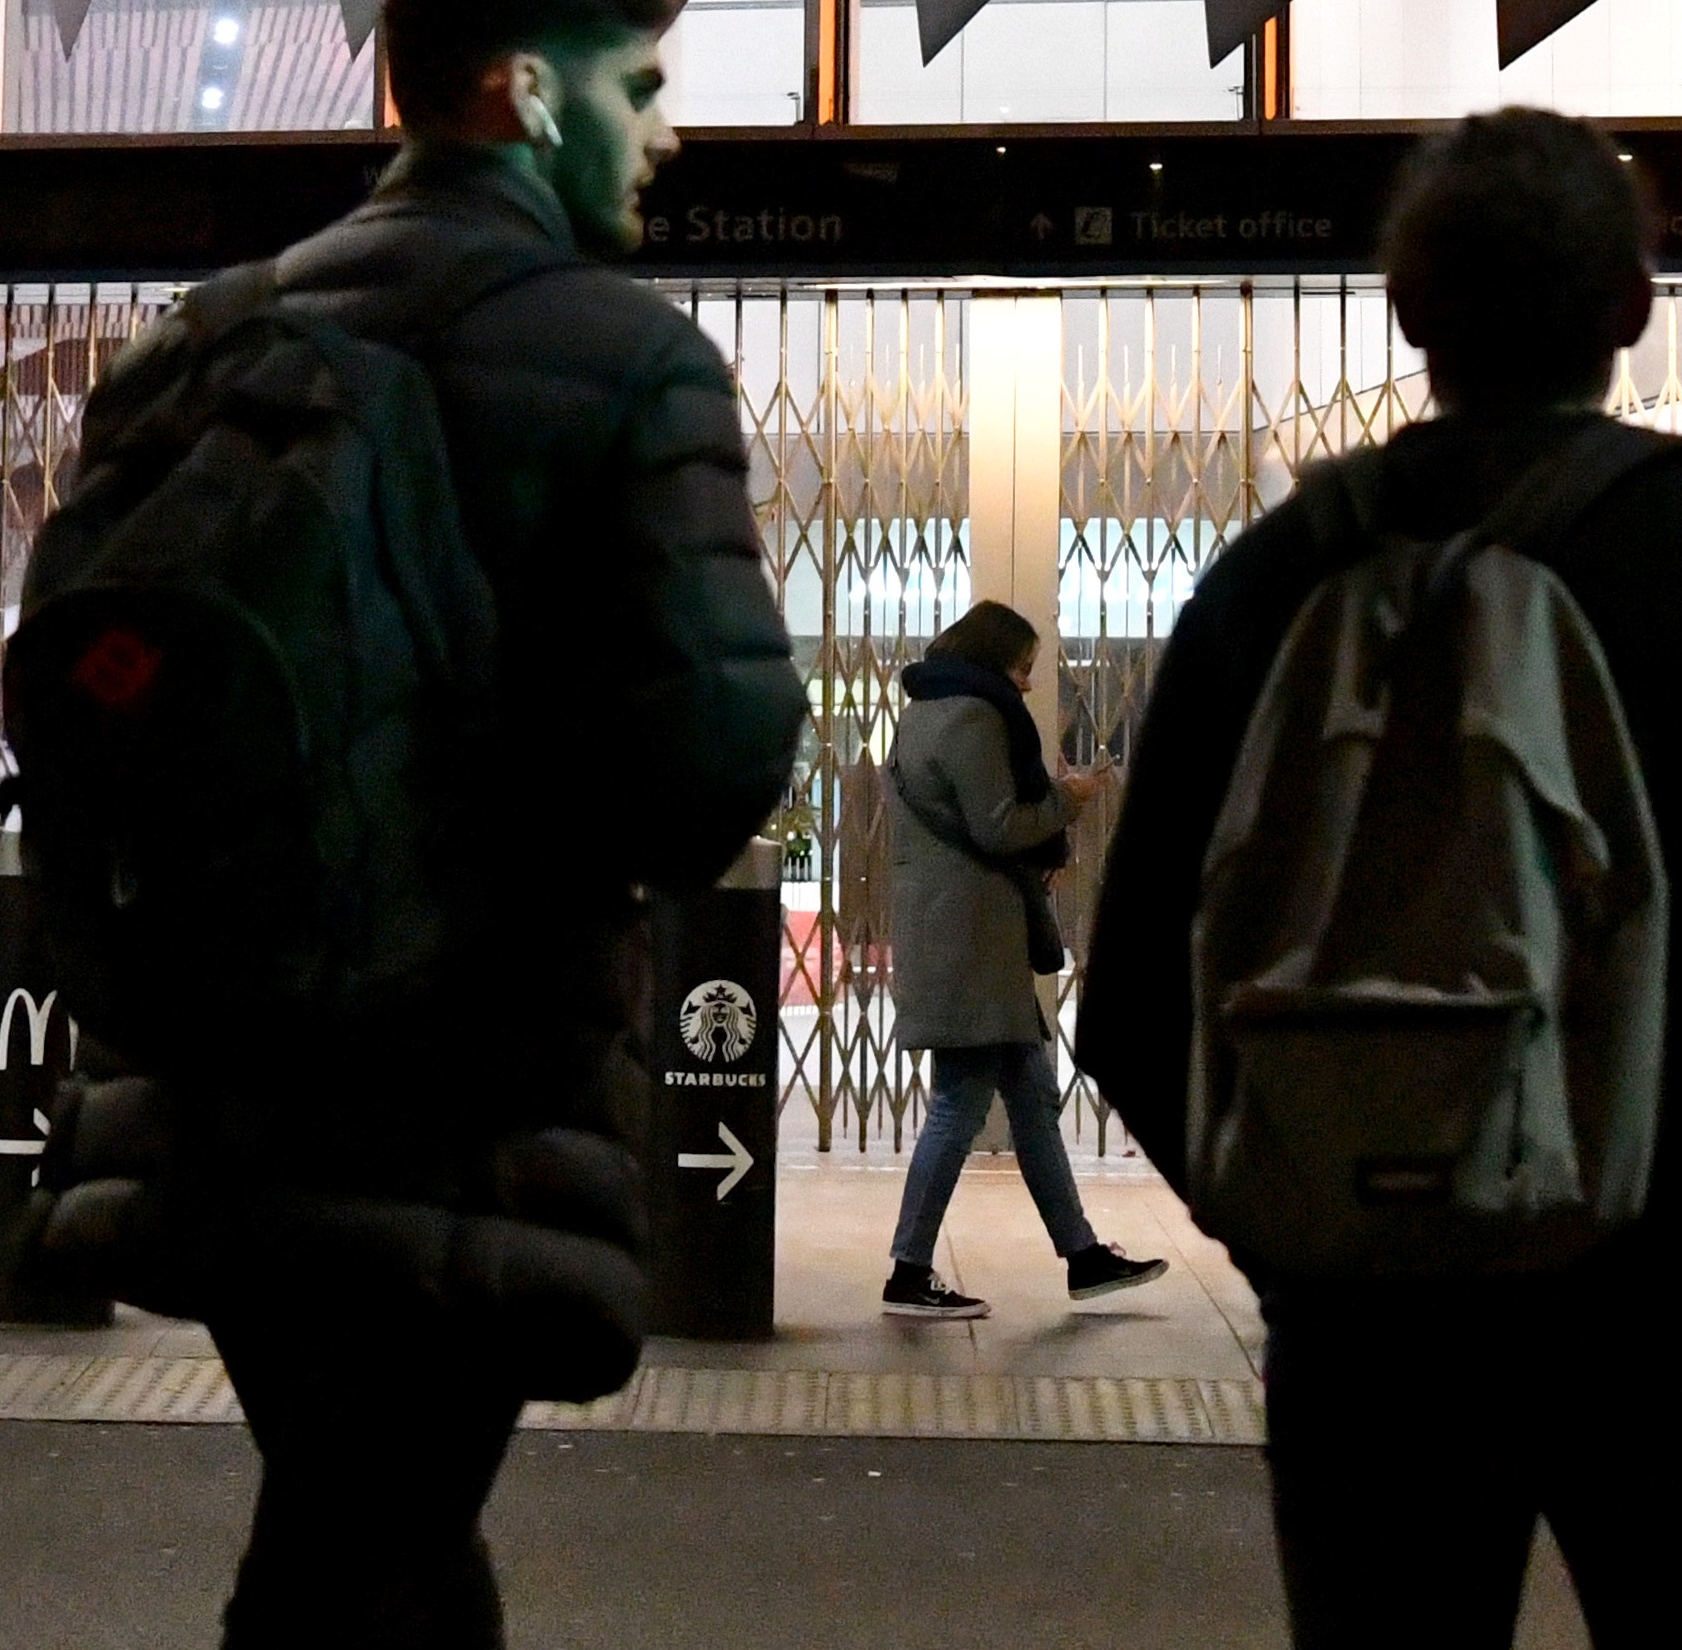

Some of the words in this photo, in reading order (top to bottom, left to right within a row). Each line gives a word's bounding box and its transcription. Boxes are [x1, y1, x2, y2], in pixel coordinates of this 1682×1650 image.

[685, 204, 845, 243] Station
[1127, 209, 1229, 239] Ticket
[1238, 208, 1333, 239] office
[664, 1070, 766, 1088] STARBUCKS
